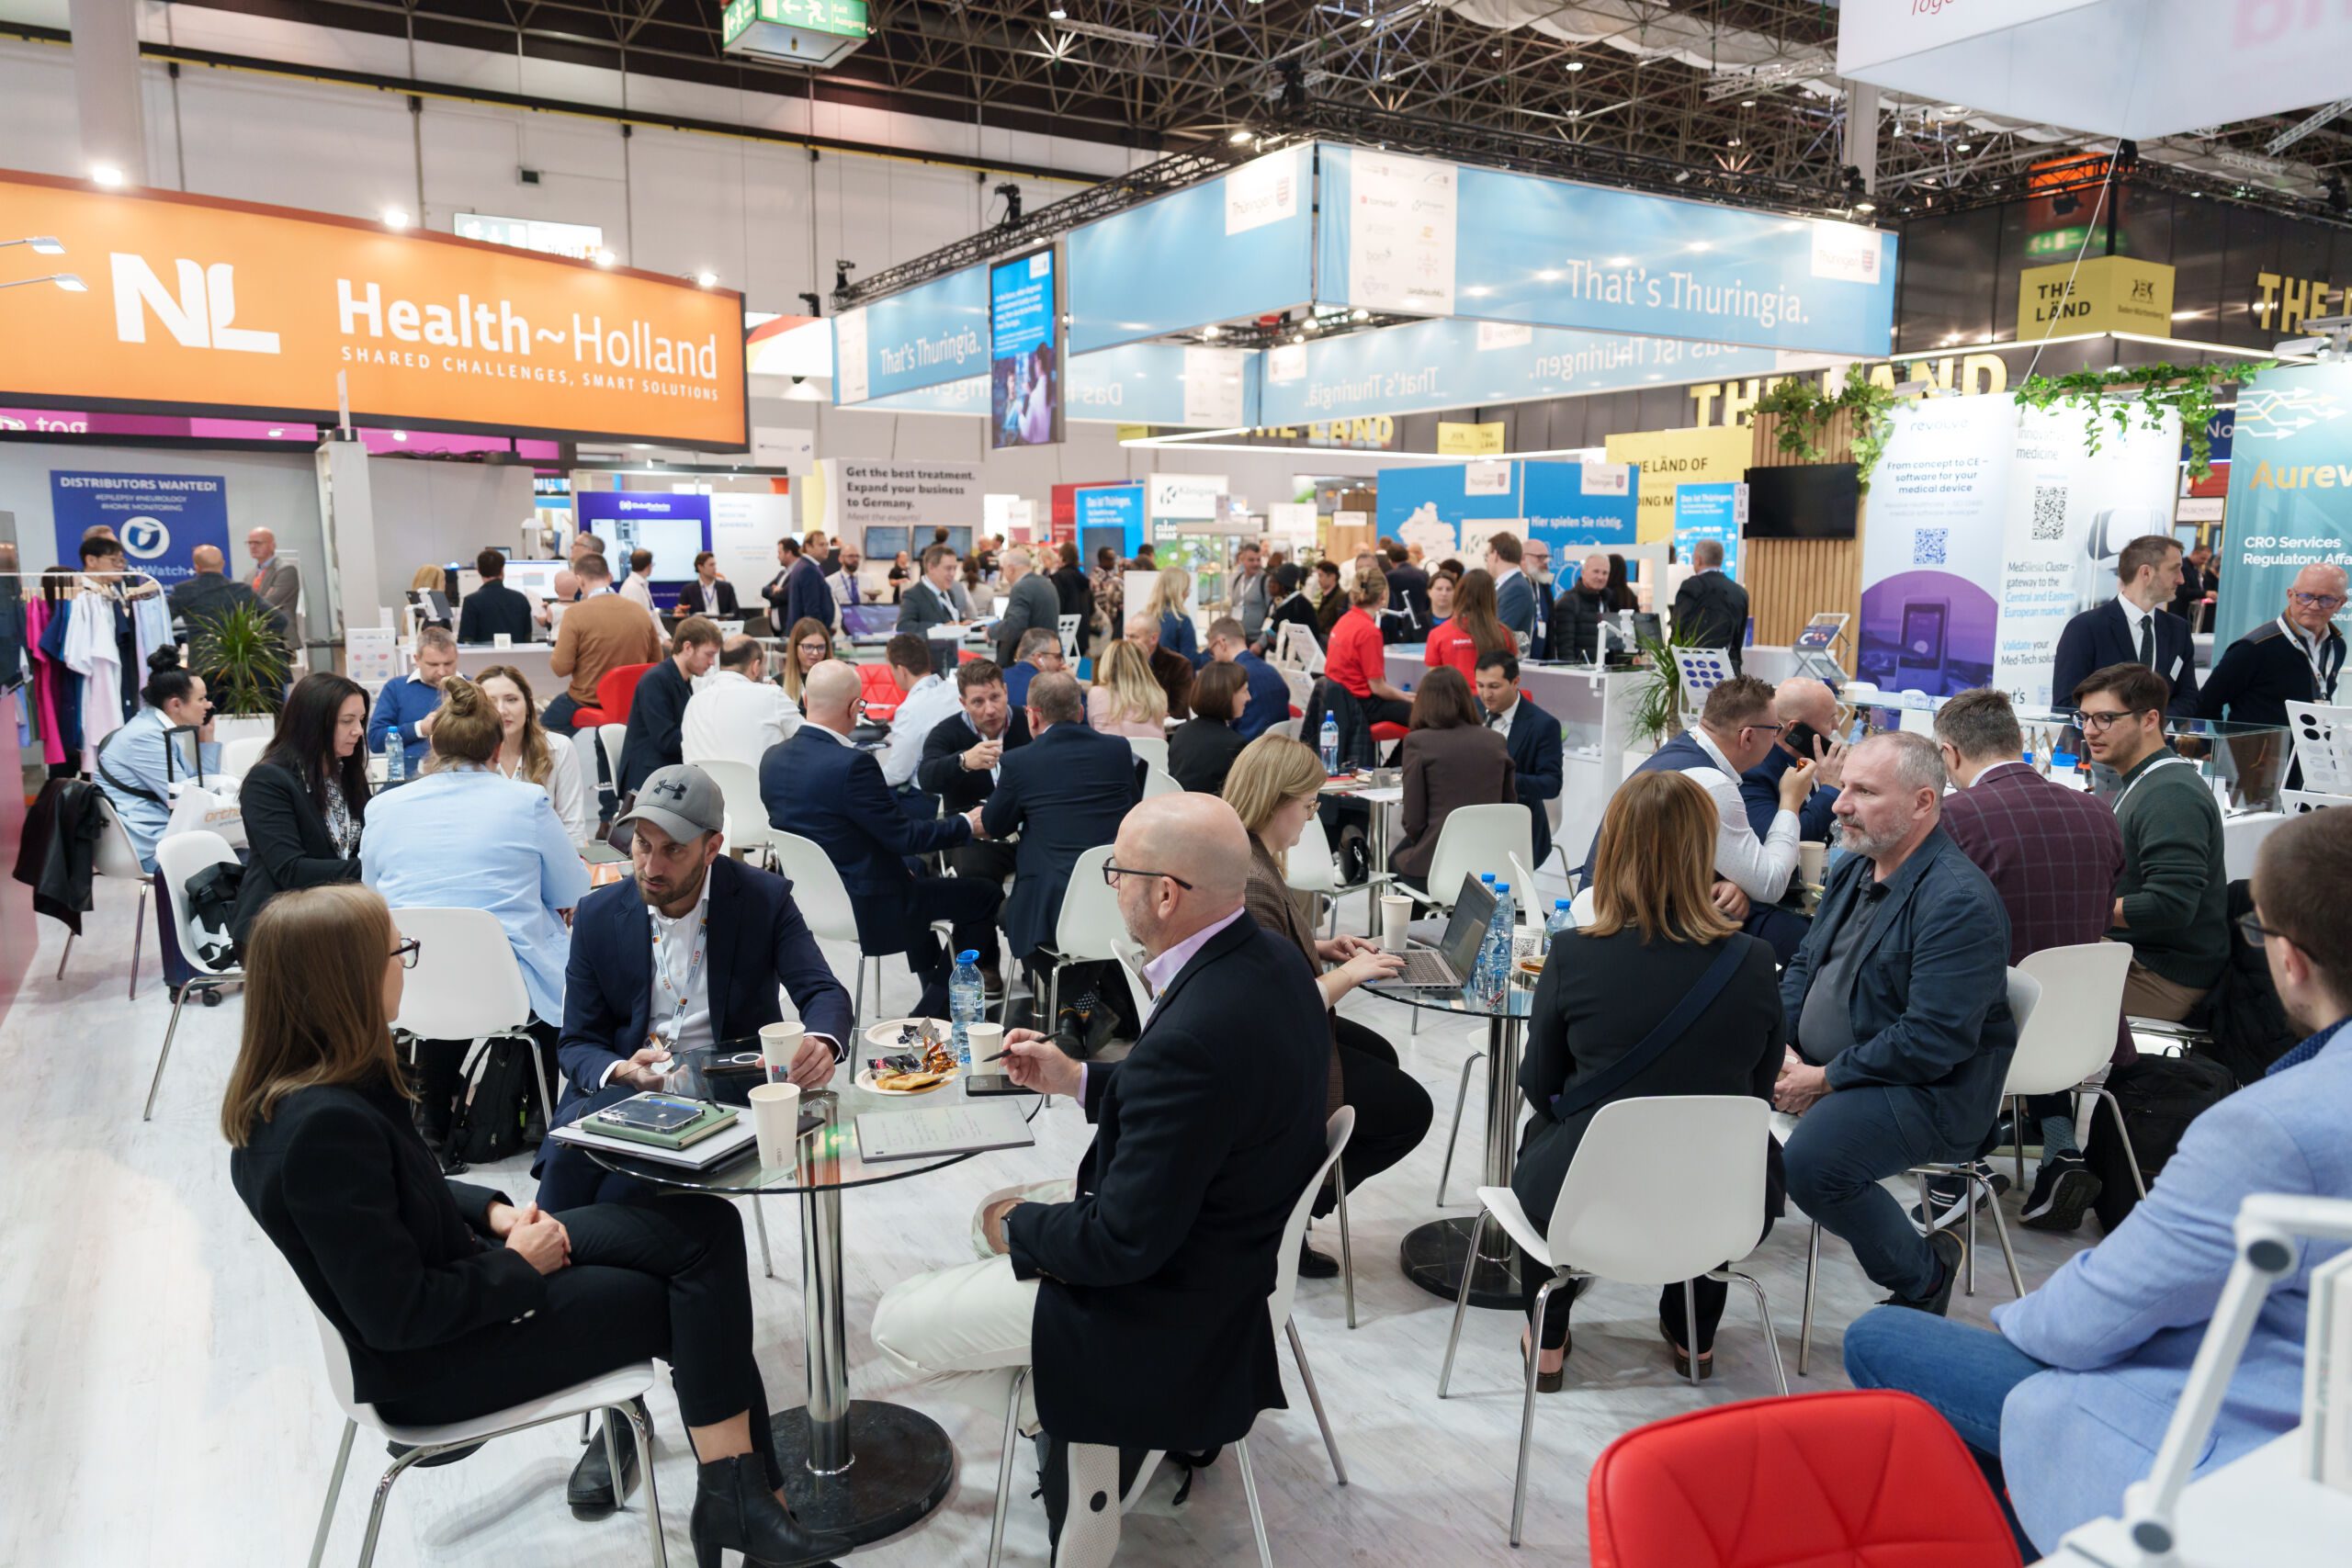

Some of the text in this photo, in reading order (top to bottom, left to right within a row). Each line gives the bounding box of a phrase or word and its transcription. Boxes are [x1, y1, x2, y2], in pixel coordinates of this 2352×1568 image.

[1566, 258, 1810, 329] That's Thuringia.
[2038, 279, 2076, 299] THE
[109, 252, 281, 354] NL
[2035, 299, 2092, 321] LÄND
[880, 342, 915, 376] That's
[916, 324, 982, 367] Thuringia.
[341, 345, 718, 401] SHARED CHALLENGES, SMART SOLUTIONS
[1652, 455, 1689, 472] LÄND
[1690, 457, 1709, 470] OF
[1887, 461, 1912, 470] From
[1913, 459, 1953, 470] concept
[1955, 458, 1965, 467] to
[1966, 457, 1980, 467] CE
[846, 467, 976, 480] Get the best treatment.
[1895, 471, 1977, 484] software for your
[60, 476, 217, 492] DISTRIBUTORS WANTED!
[846, 482, 965, 495] Expand your business
[1898, 482, 1973, 493] medical device
[847, 497, 915, 510] to Germany.
[1531, 515, 1549, 526] Hier
[1550, 515, 1580, 528] spielen
[1581, 516, 1595, 528] Sie
[2245, 536, 2342, 548] CRO Services
[2045, 561, 2069, 572] Cluster
[2243, 553, 2323, 568] Regulatory
[2007, 577, 2060, 590] gateway to the
[2005, 592, 2075, 604] Central and Eastern
[2004, 606, 2040, 619] European
[2003, 640, 2049, 652] Validate your
[2001, 654, 2037, 666] Med-Tech
